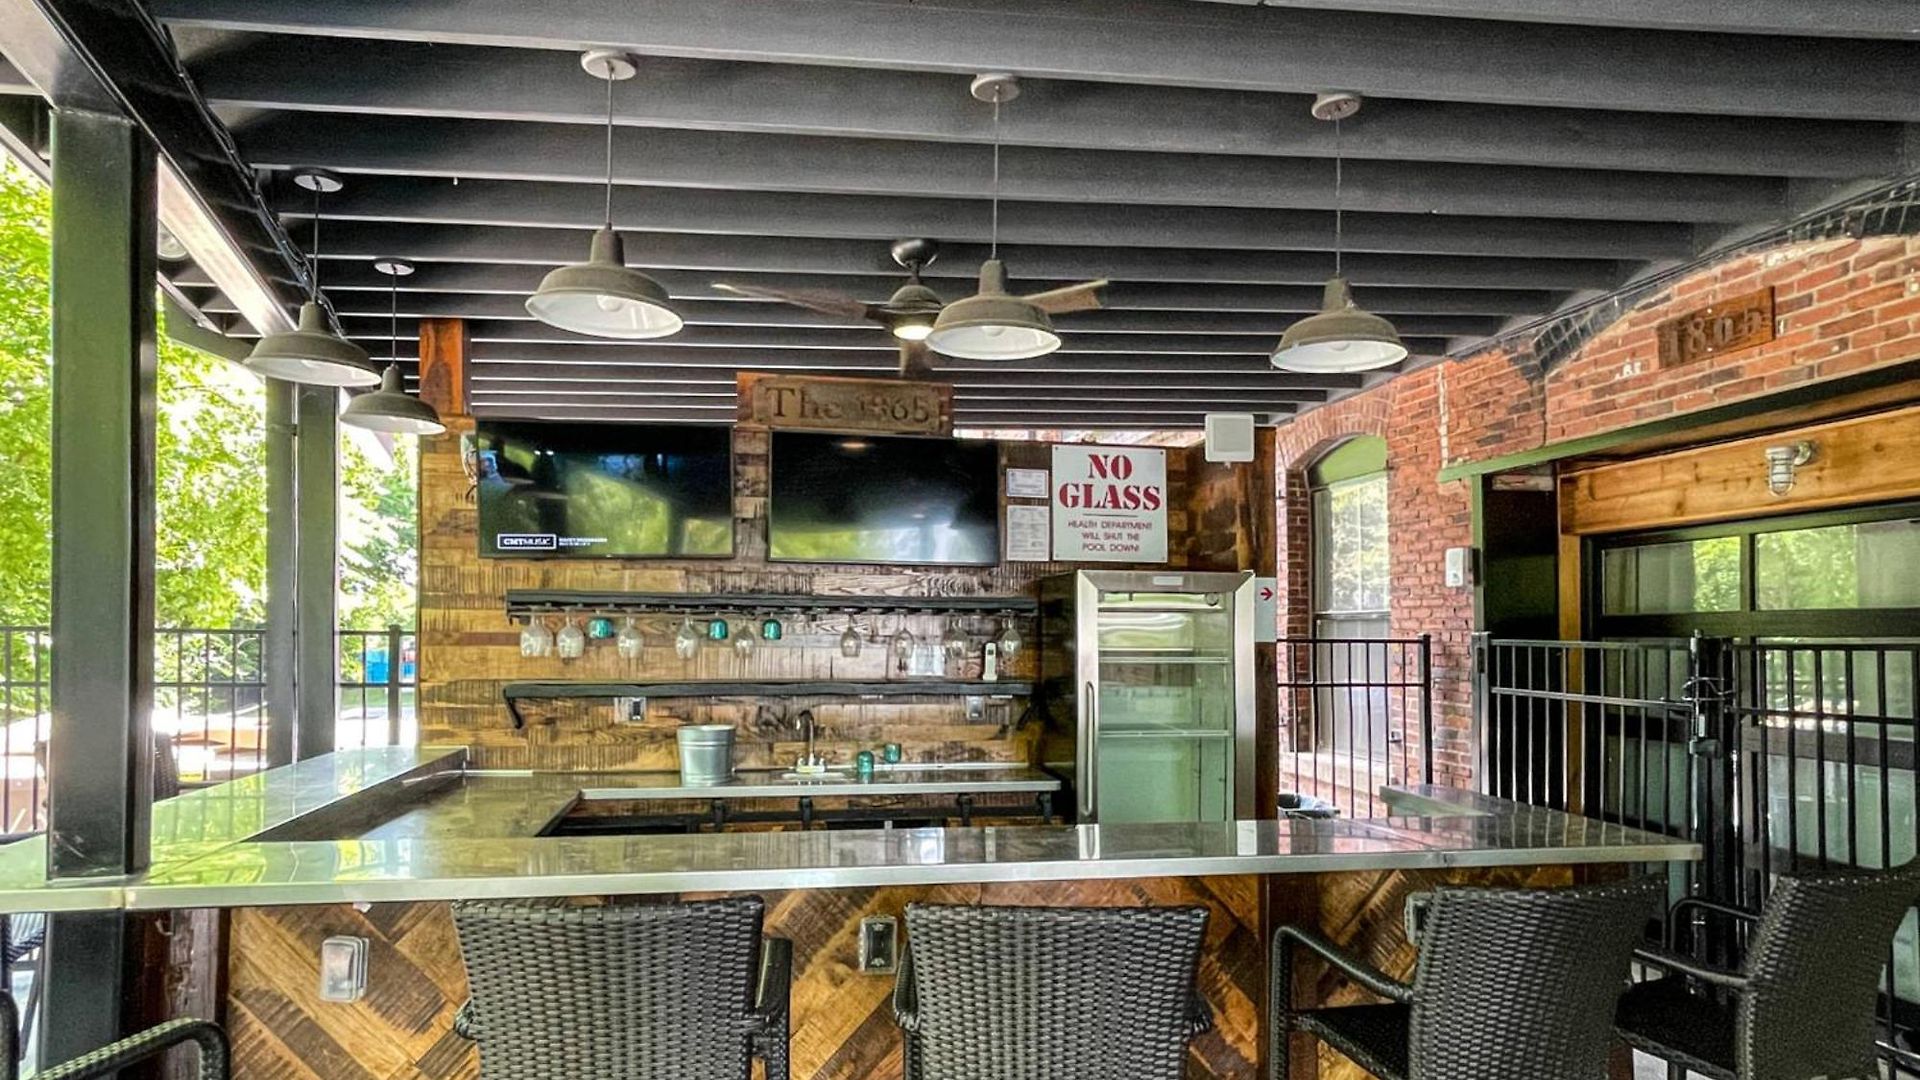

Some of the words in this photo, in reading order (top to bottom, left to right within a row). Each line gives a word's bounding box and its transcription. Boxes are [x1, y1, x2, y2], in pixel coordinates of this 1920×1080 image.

[765, 386, 843, 420] The
[1088, 453, 1133, 480] NO
[1058, 482, 1161, 511] GLASS
[1067, 520, 1098, 529] HEALTH
[1101, 520, 1153, 530] DEPARTMENT
[1081, 531, 1101, 541] WILL
[1103, 532, 1123, 541] SHUT
[1126, 532, 1140, 541] THE
[1082, 543, 1106, 552] POOL
